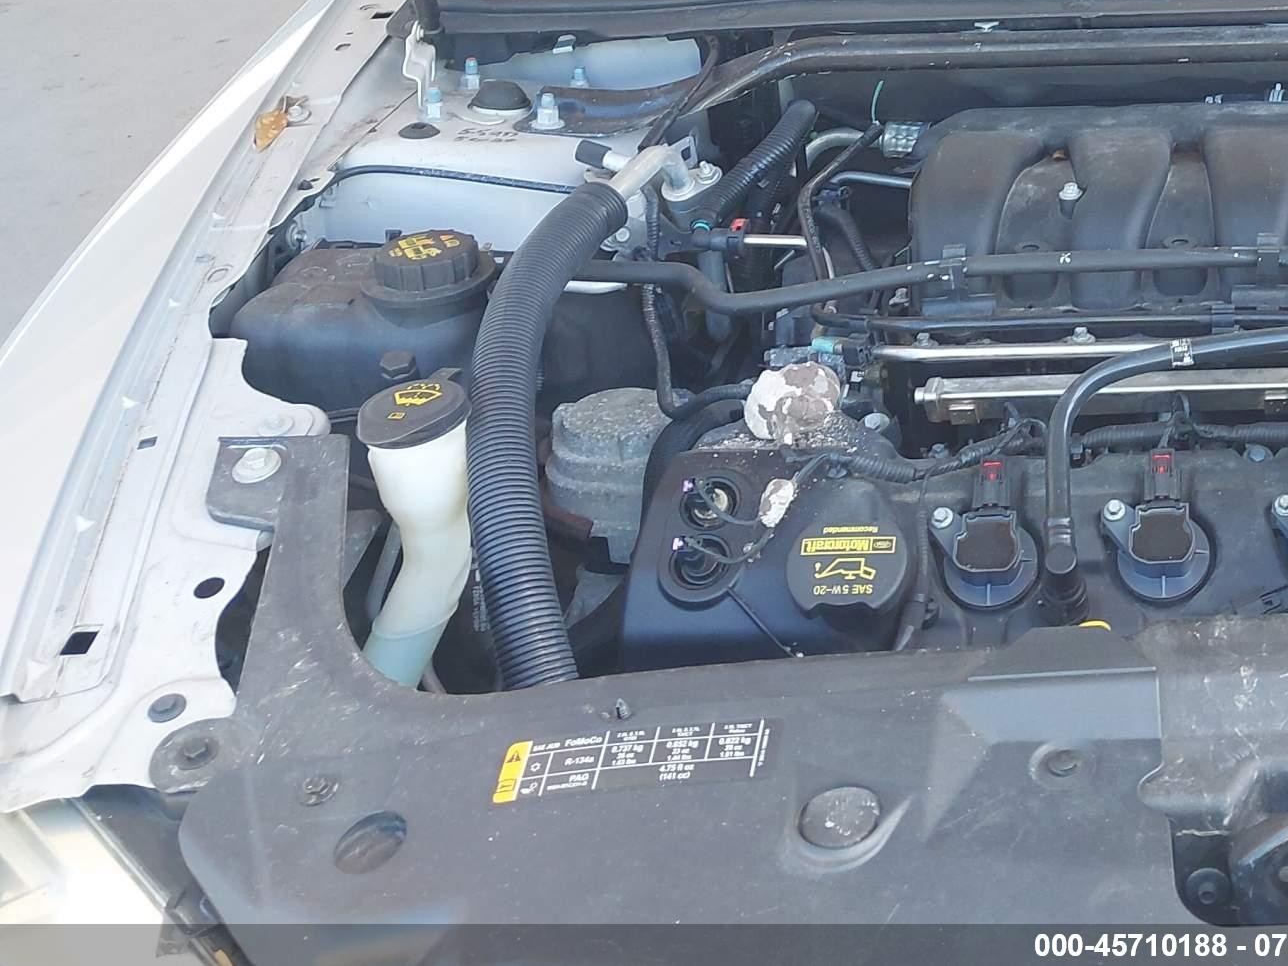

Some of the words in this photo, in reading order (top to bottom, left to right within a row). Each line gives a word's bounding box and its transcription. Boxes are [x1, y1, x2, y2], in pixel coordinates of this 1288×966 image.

[823, 526, 878, 534] Recommended
[806, 537, 870, 552] Motorcraft
[813, 585, 849, 595] 5W-20
[851, 584, 873, 594] SAE
[564, 736, 603, 747] FoMoCo
[688, 740, 699, 748] kg
[741, 737, 751, 745] kg
[633, 744, 644, 752] kg
[564, 755, 595, 766] R-134a
